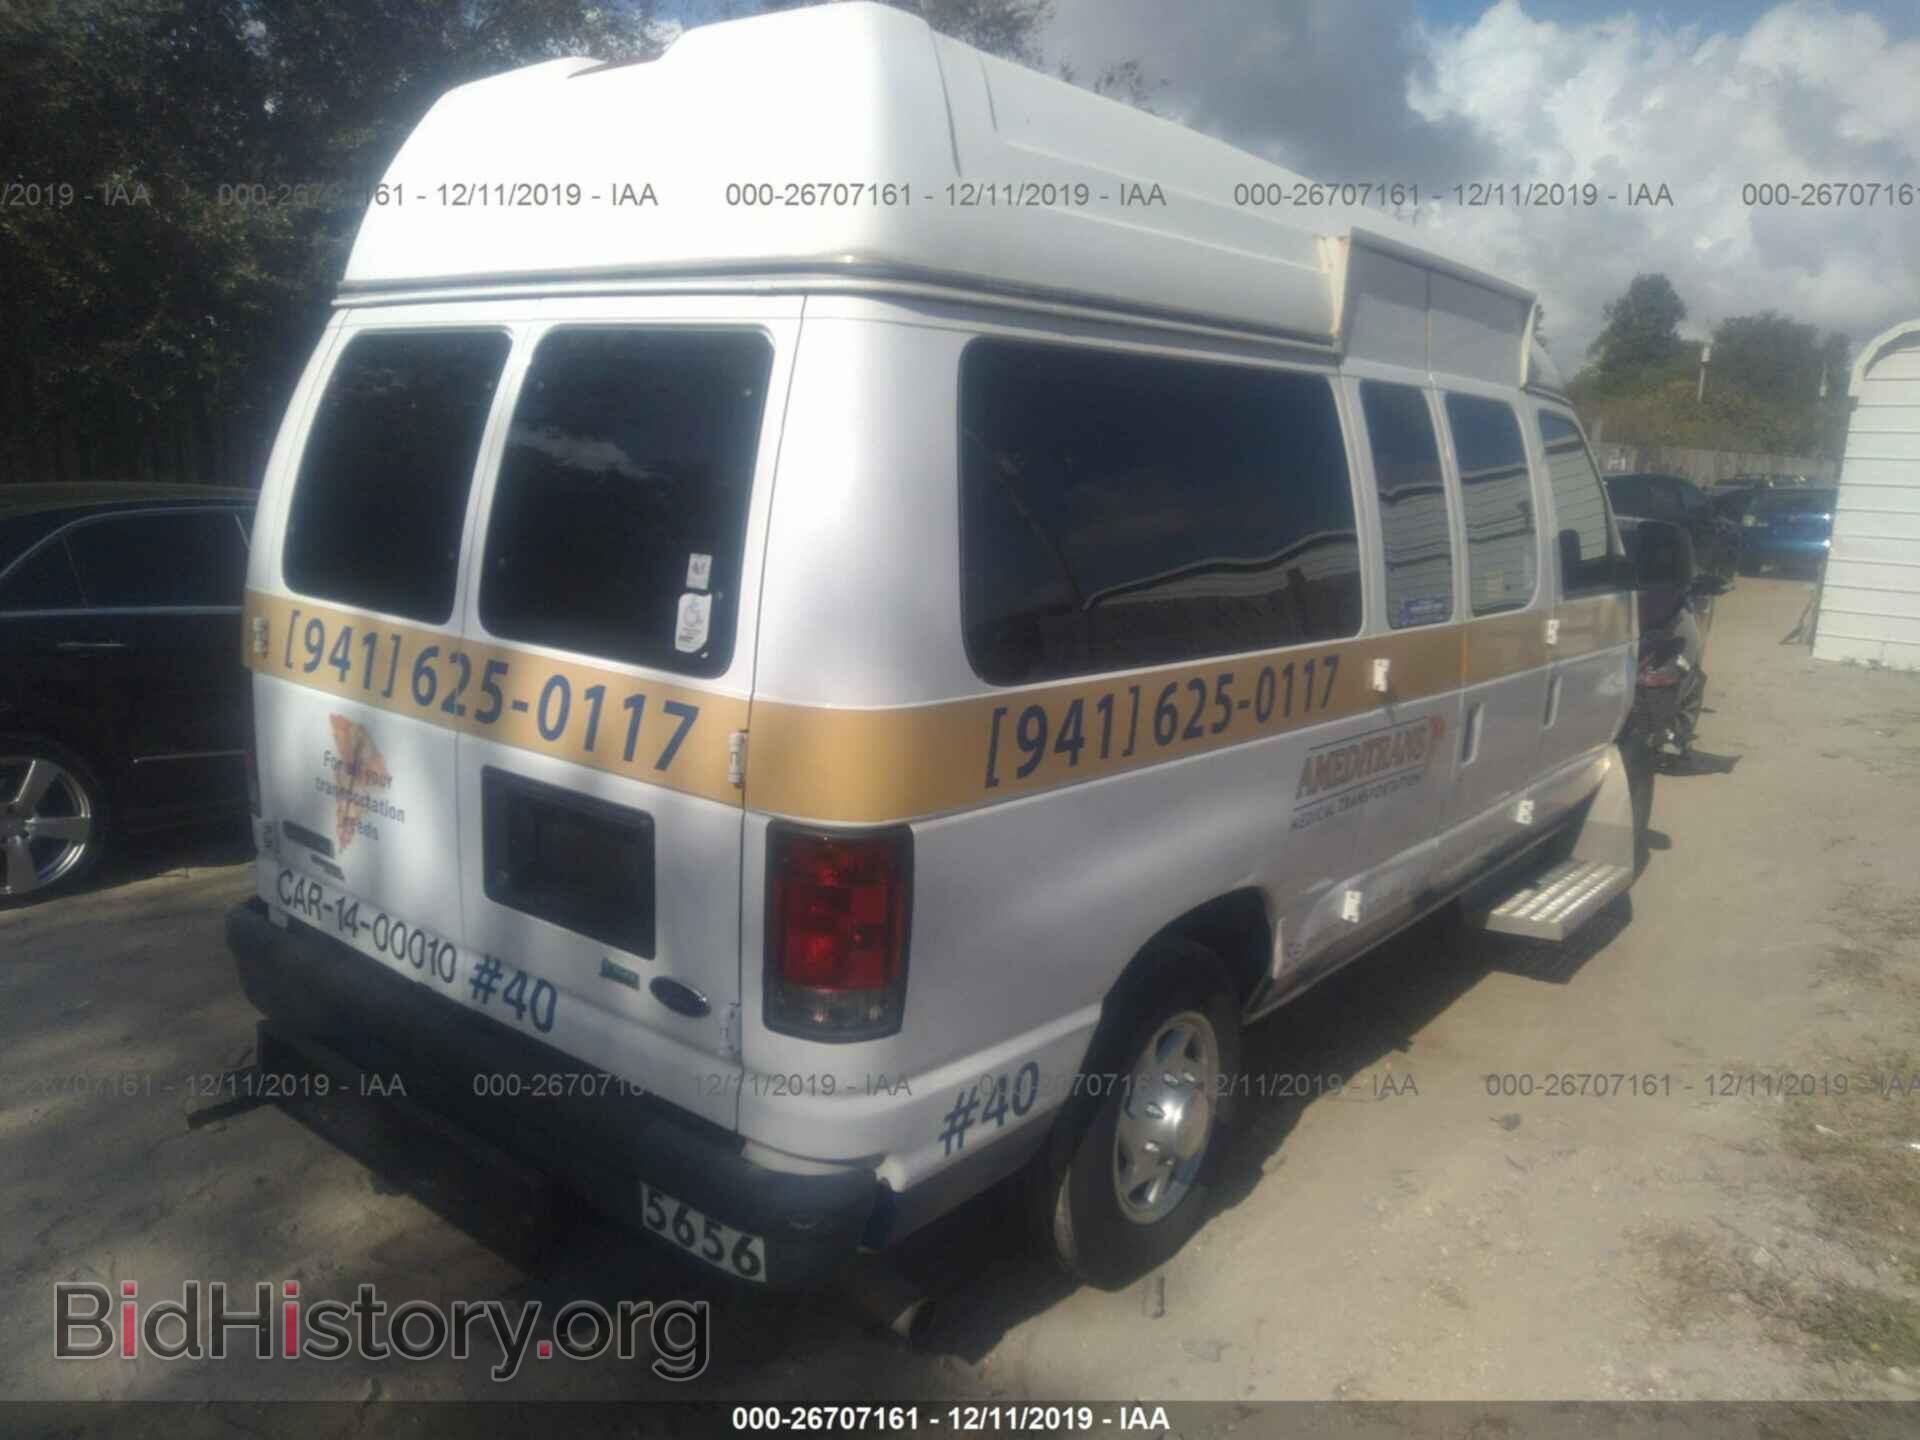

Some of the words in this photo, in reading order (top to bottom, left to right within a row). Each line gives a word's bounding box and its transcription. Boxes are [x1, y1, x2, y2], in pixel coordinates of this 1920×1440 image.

[276, 868, 457, 984] CAR-14-00010
[468, 953, 558, 1034] #40
[938, 1062, 1039, 1157] #40
[646, 1189, 761, 1278] 5656
